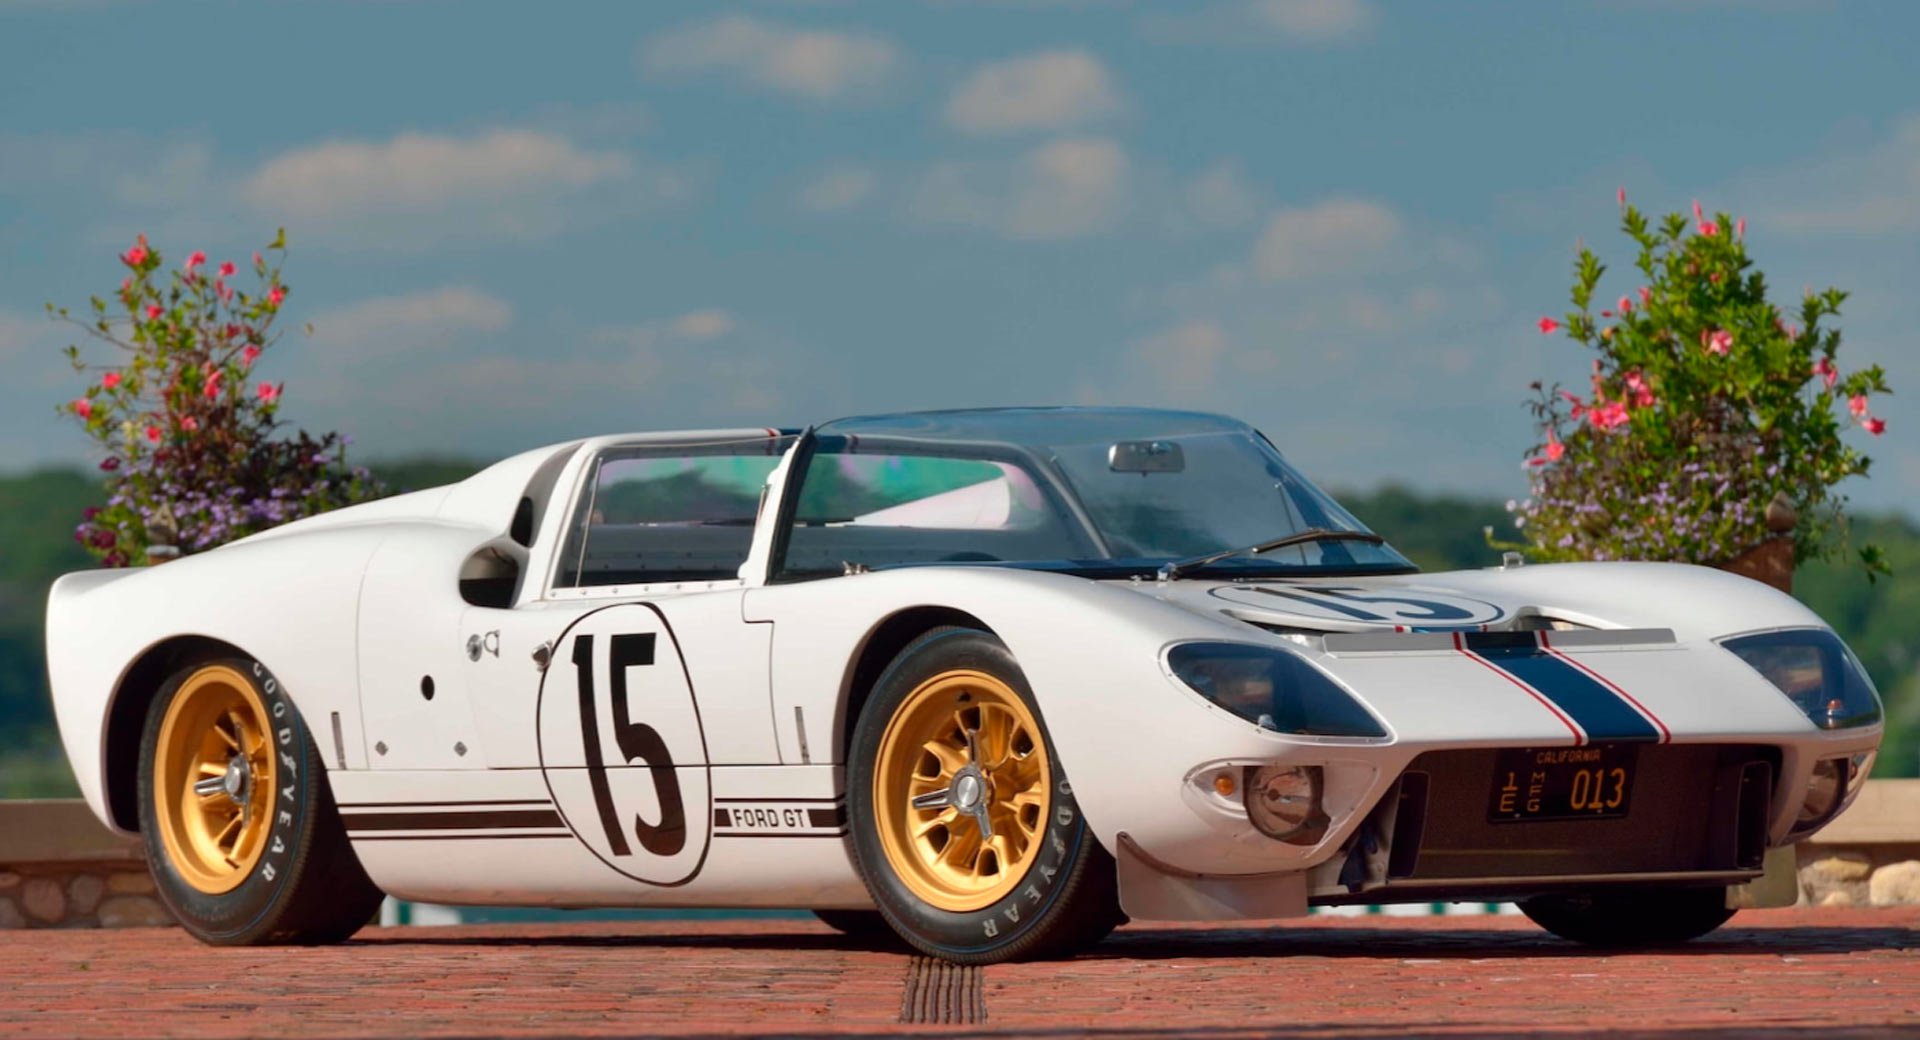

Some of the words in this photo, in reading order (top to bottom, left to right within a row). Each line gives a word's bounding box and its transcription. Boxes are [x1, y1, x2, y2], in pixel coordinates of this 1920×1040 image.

[1234, 586, 1474, 621] 15
[571, 632, 686, 856] 15
[1536, 750, 1600, 764] CALIFORNIA
[1570, 768, 1626, 810] 013
[733, 808, 779, 828] FORD
[783, 808, 804, 828] GT
[974, 779, 1073, 938] ODYEAR
